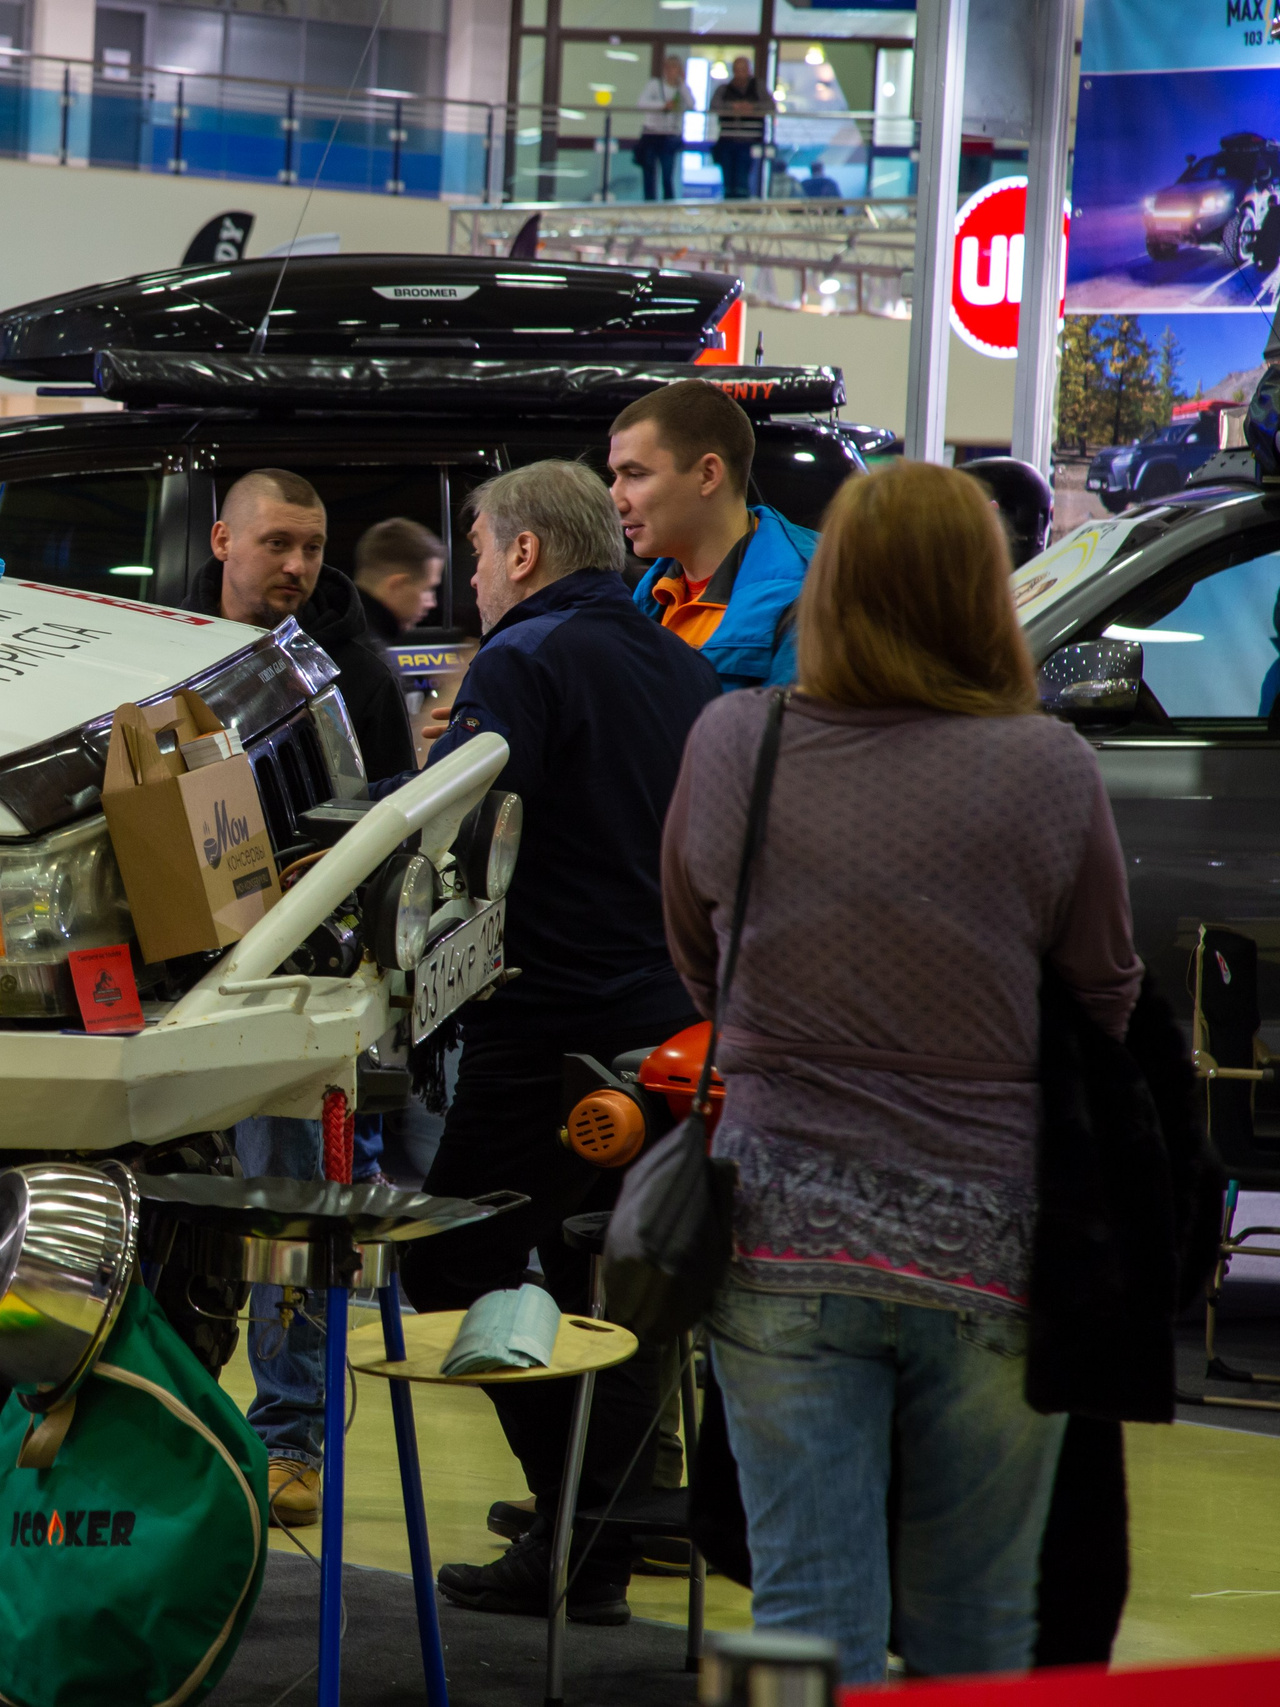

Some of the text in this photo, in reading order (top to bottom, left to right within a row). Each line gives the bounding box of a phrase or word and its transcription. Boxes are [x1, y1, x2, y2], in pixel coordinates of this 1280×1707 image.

[394, 288, 457, 298] BROOMER
[714, 382, 774, 400] ENTY
[227, 845, 265, 872] консервы
